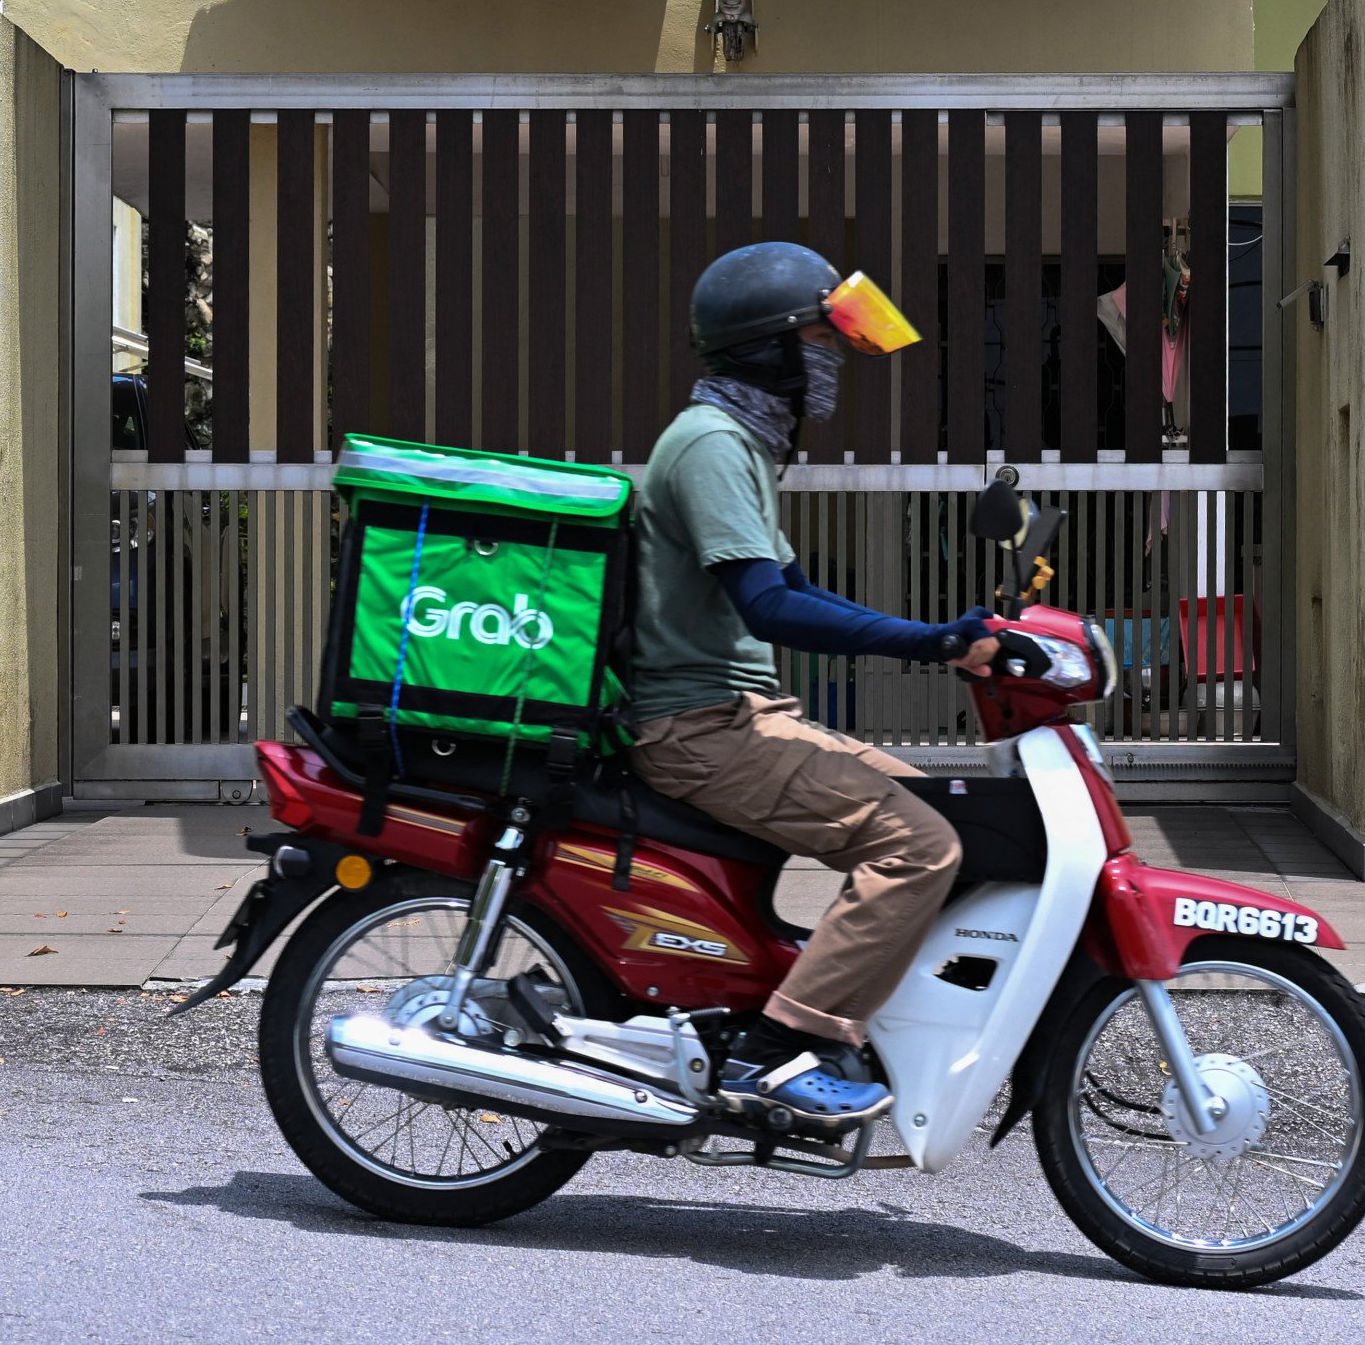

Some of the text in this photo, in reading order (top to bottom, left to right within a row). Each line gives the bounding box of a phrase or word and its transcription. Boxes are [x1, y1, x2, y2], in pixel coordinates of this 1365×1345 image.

[400, 586, 554, 650] Grab
[955, 928, 1019, 942] HONDA
[1173, 897, 1319, 944] BQR6613
